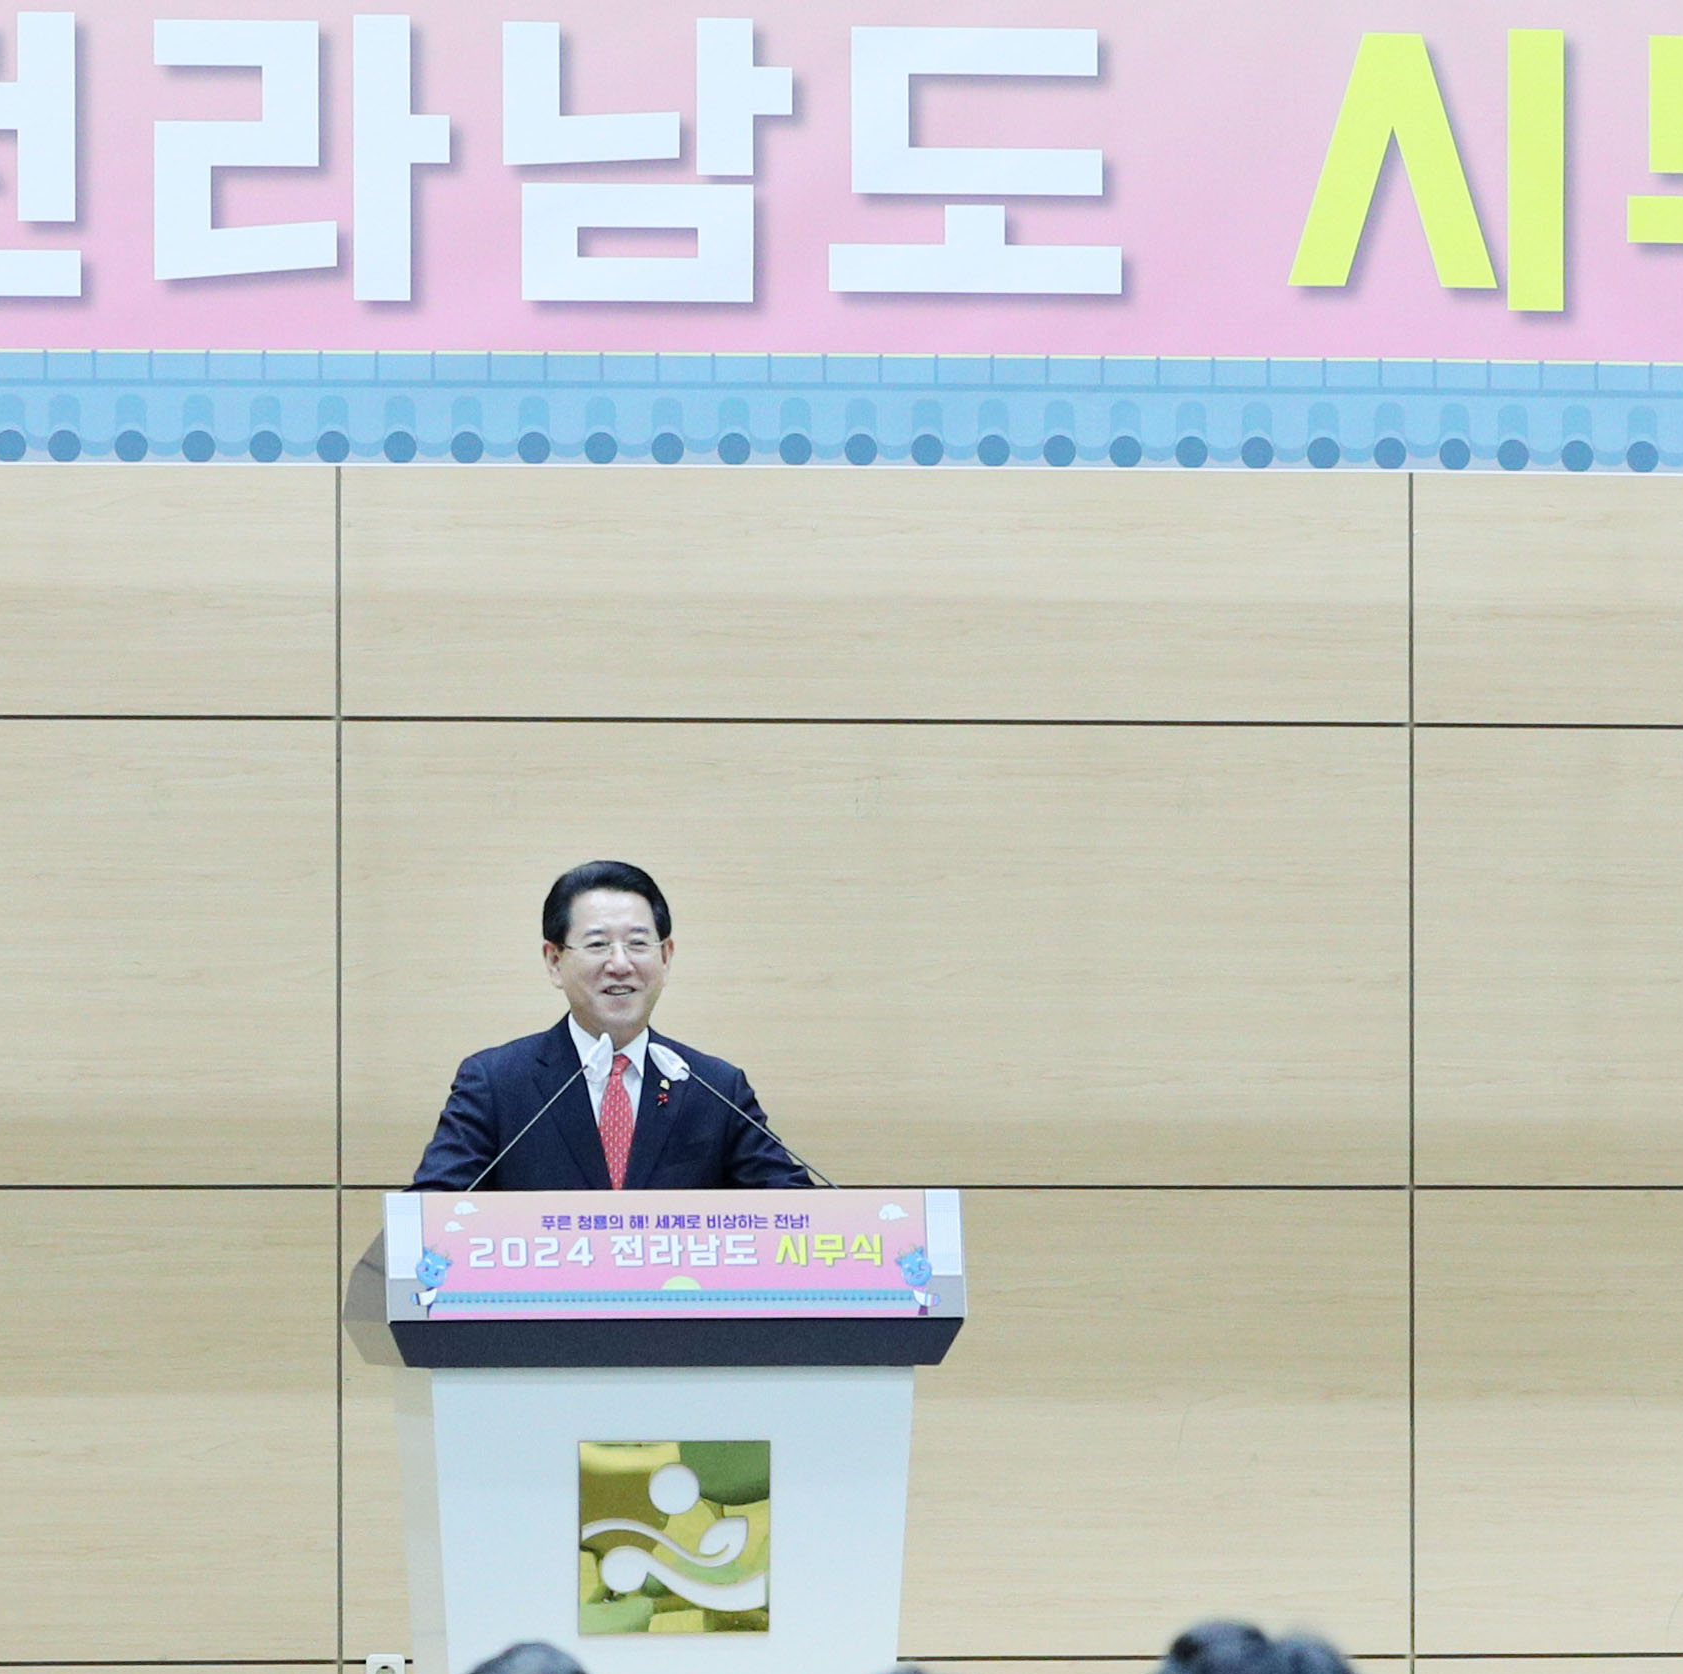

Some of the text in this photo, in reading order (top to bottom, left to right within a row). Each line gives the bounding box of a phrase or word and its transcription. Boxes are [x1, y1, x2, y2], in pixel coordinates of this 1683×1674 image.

[541, 1213, 810, 1230] 푸른 청룡의 해! 세계로 비상하는 전남!
[468, 1233, 883, 1268] 2024 전라남도 시무식
